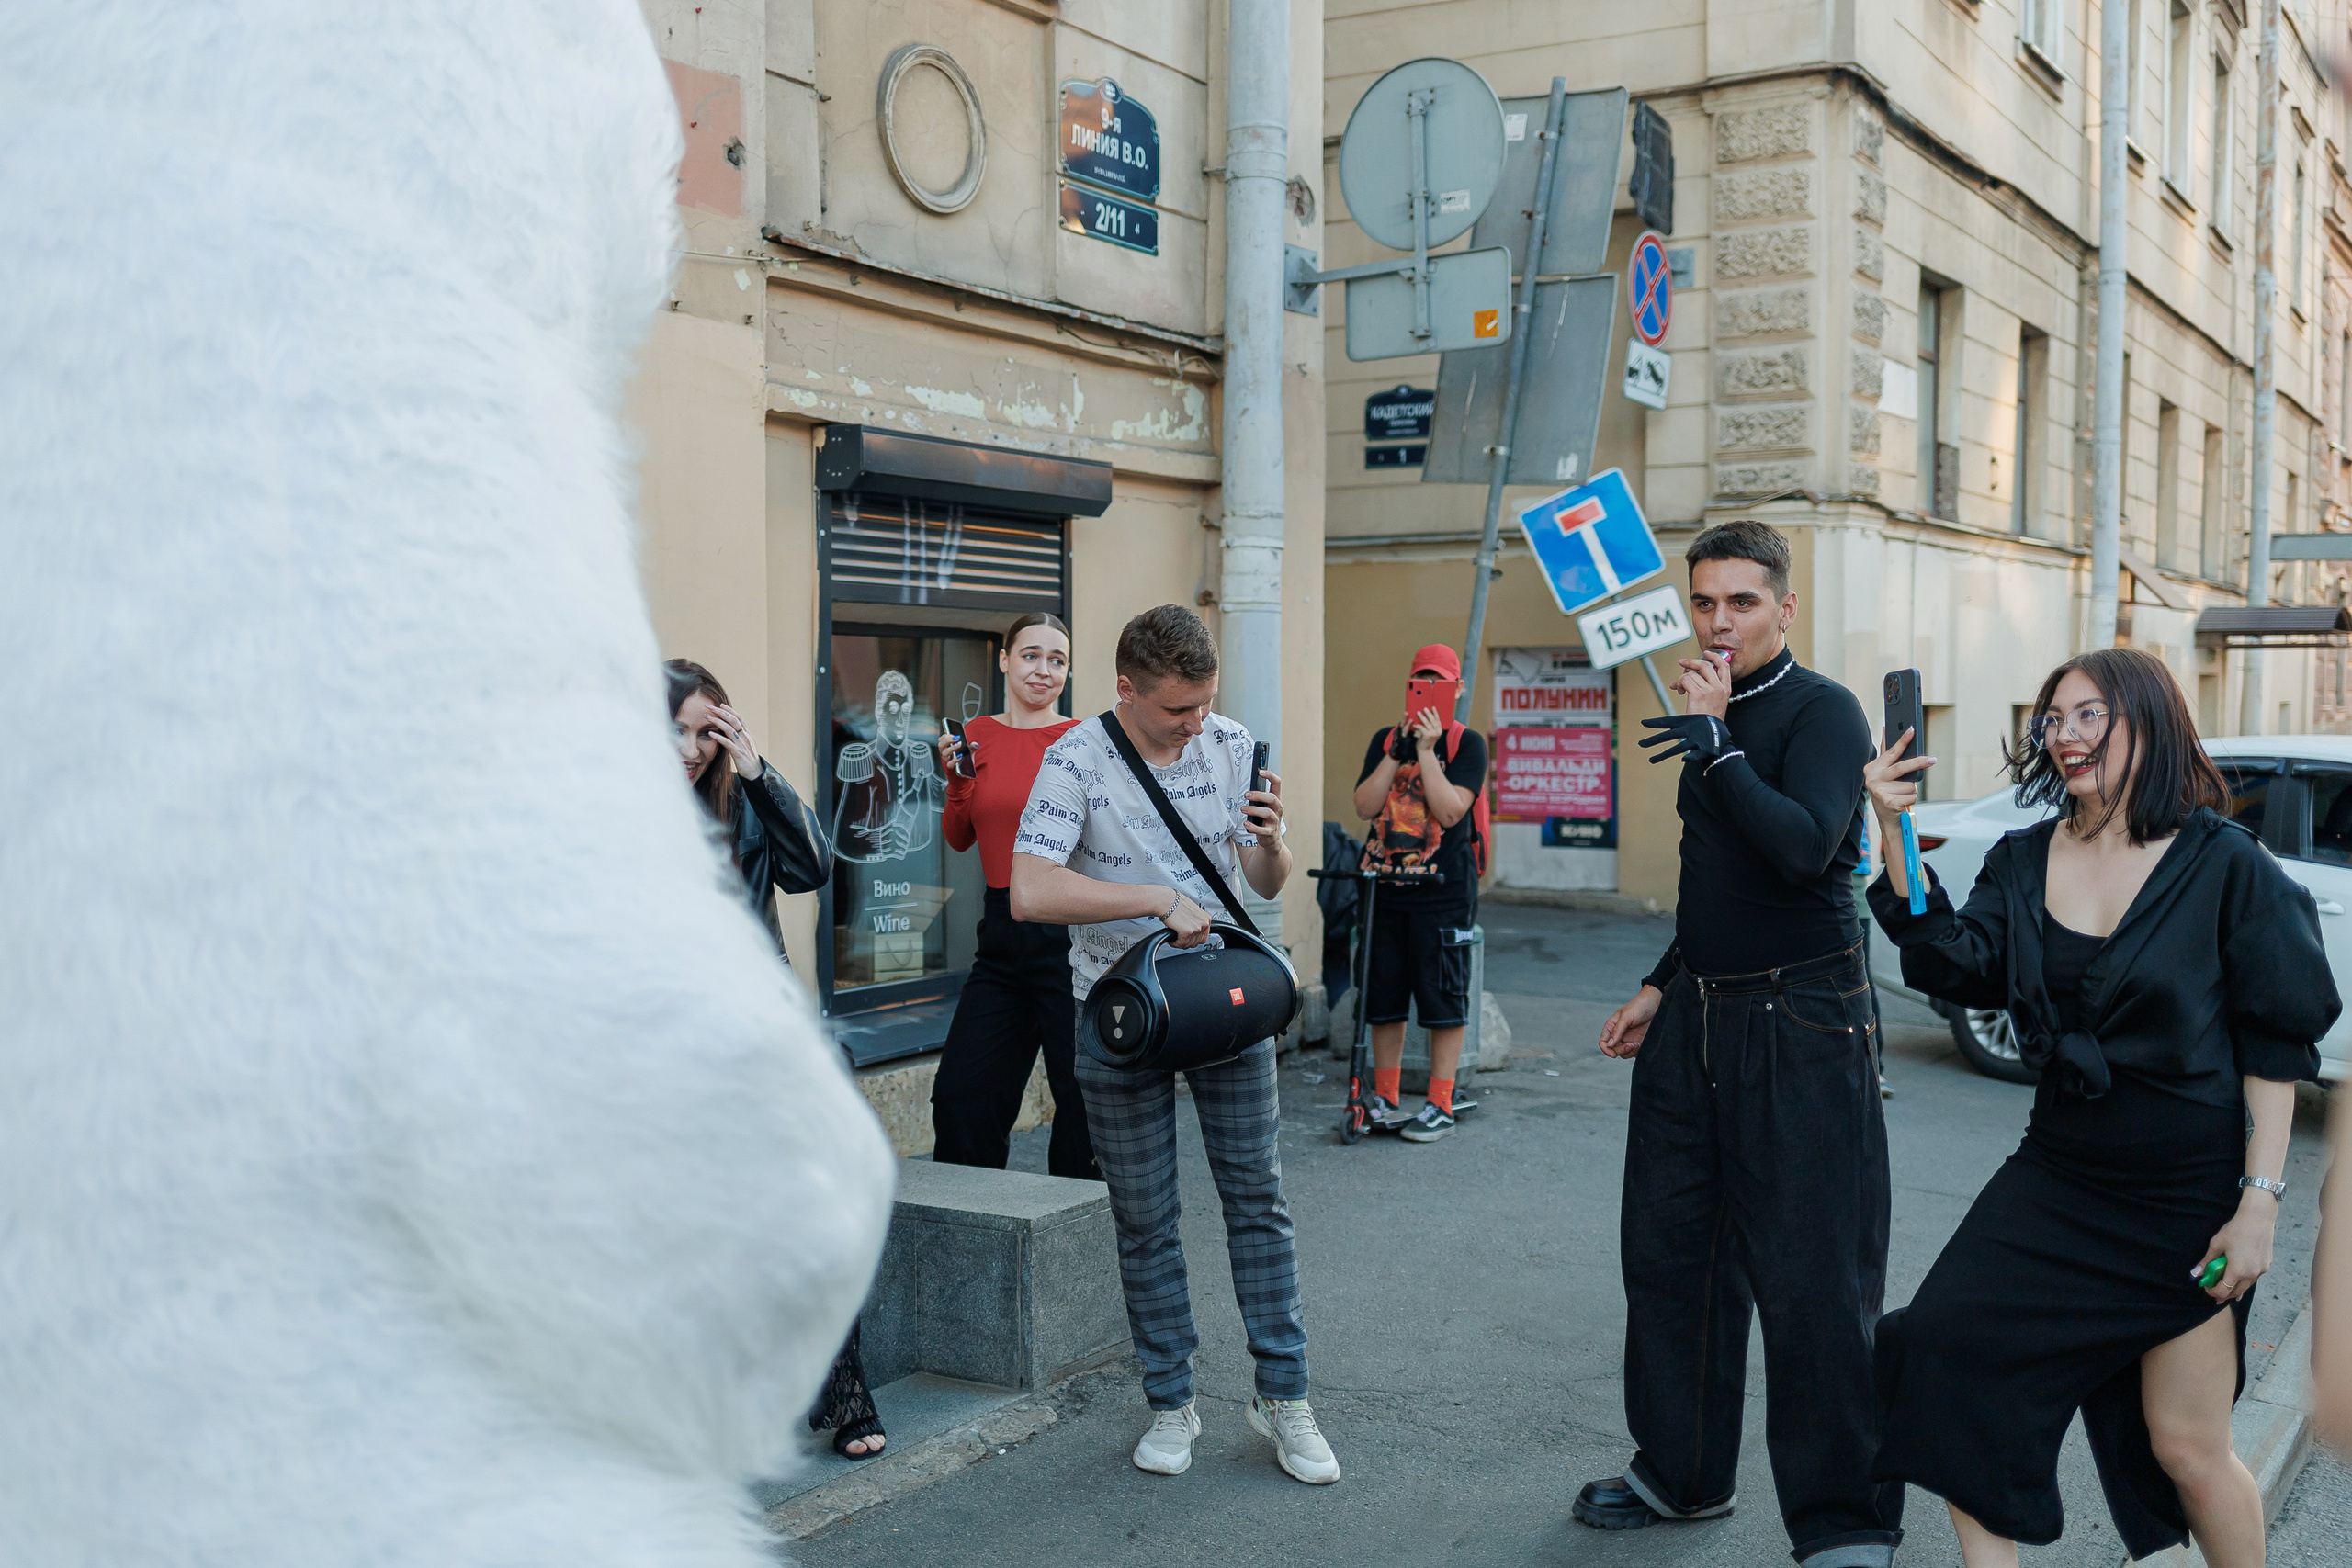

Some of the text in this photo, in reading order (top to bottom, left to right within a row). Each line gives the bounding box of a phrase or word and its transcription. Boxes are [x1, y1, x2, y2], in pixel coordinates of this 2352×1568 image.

[1071, 123, 1149, 170] ЛИНИЯ В.О.
[1094, 202, 1125, 238] 2/11
[1397, 447, 1408, 465] 1
[1501, 687, 1607, 710] ПОЛУНИН
[1506, 733, 1518, 751] 4
[1507, 756, 1606, 776] ВИВАЛЬДИ
[1037, 799, 1068, 819] Palm
[1033, 833, 1068, 852] Angels
[1076, 840, 1097, 861] Palm
[1098, 851, 1133, 869] Angels
[873, 879, 911, 898] Вино
[872, 912, 910, 933] Wine
[1086, 926, 1136, 957] Angel
